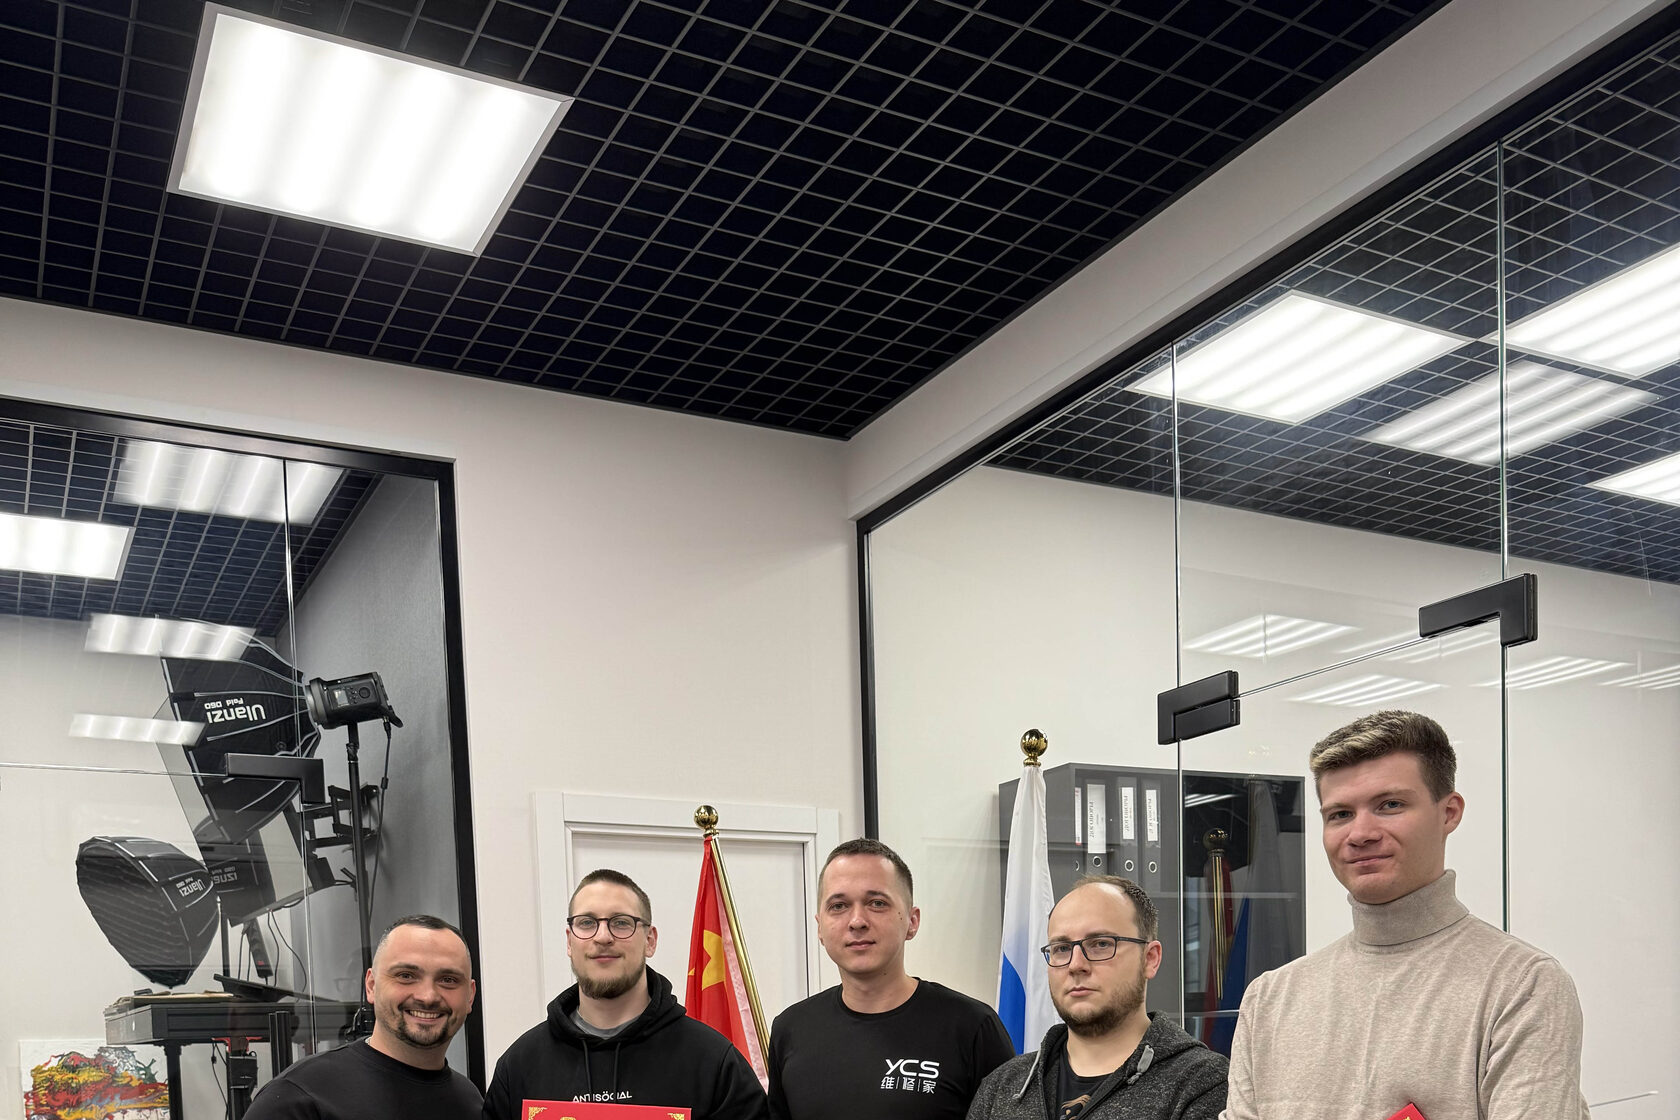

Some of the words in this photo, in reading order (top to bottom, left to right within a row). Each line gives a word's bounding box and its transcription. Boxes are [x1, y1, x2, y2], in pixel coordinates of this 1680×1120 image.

[225, 697, 244, 706] Fold
[206, 704, 266, 723] Ulanzi
[179, 879, 206, 897] Ulanzi
[885, 1059, 940, 1079] YCS
